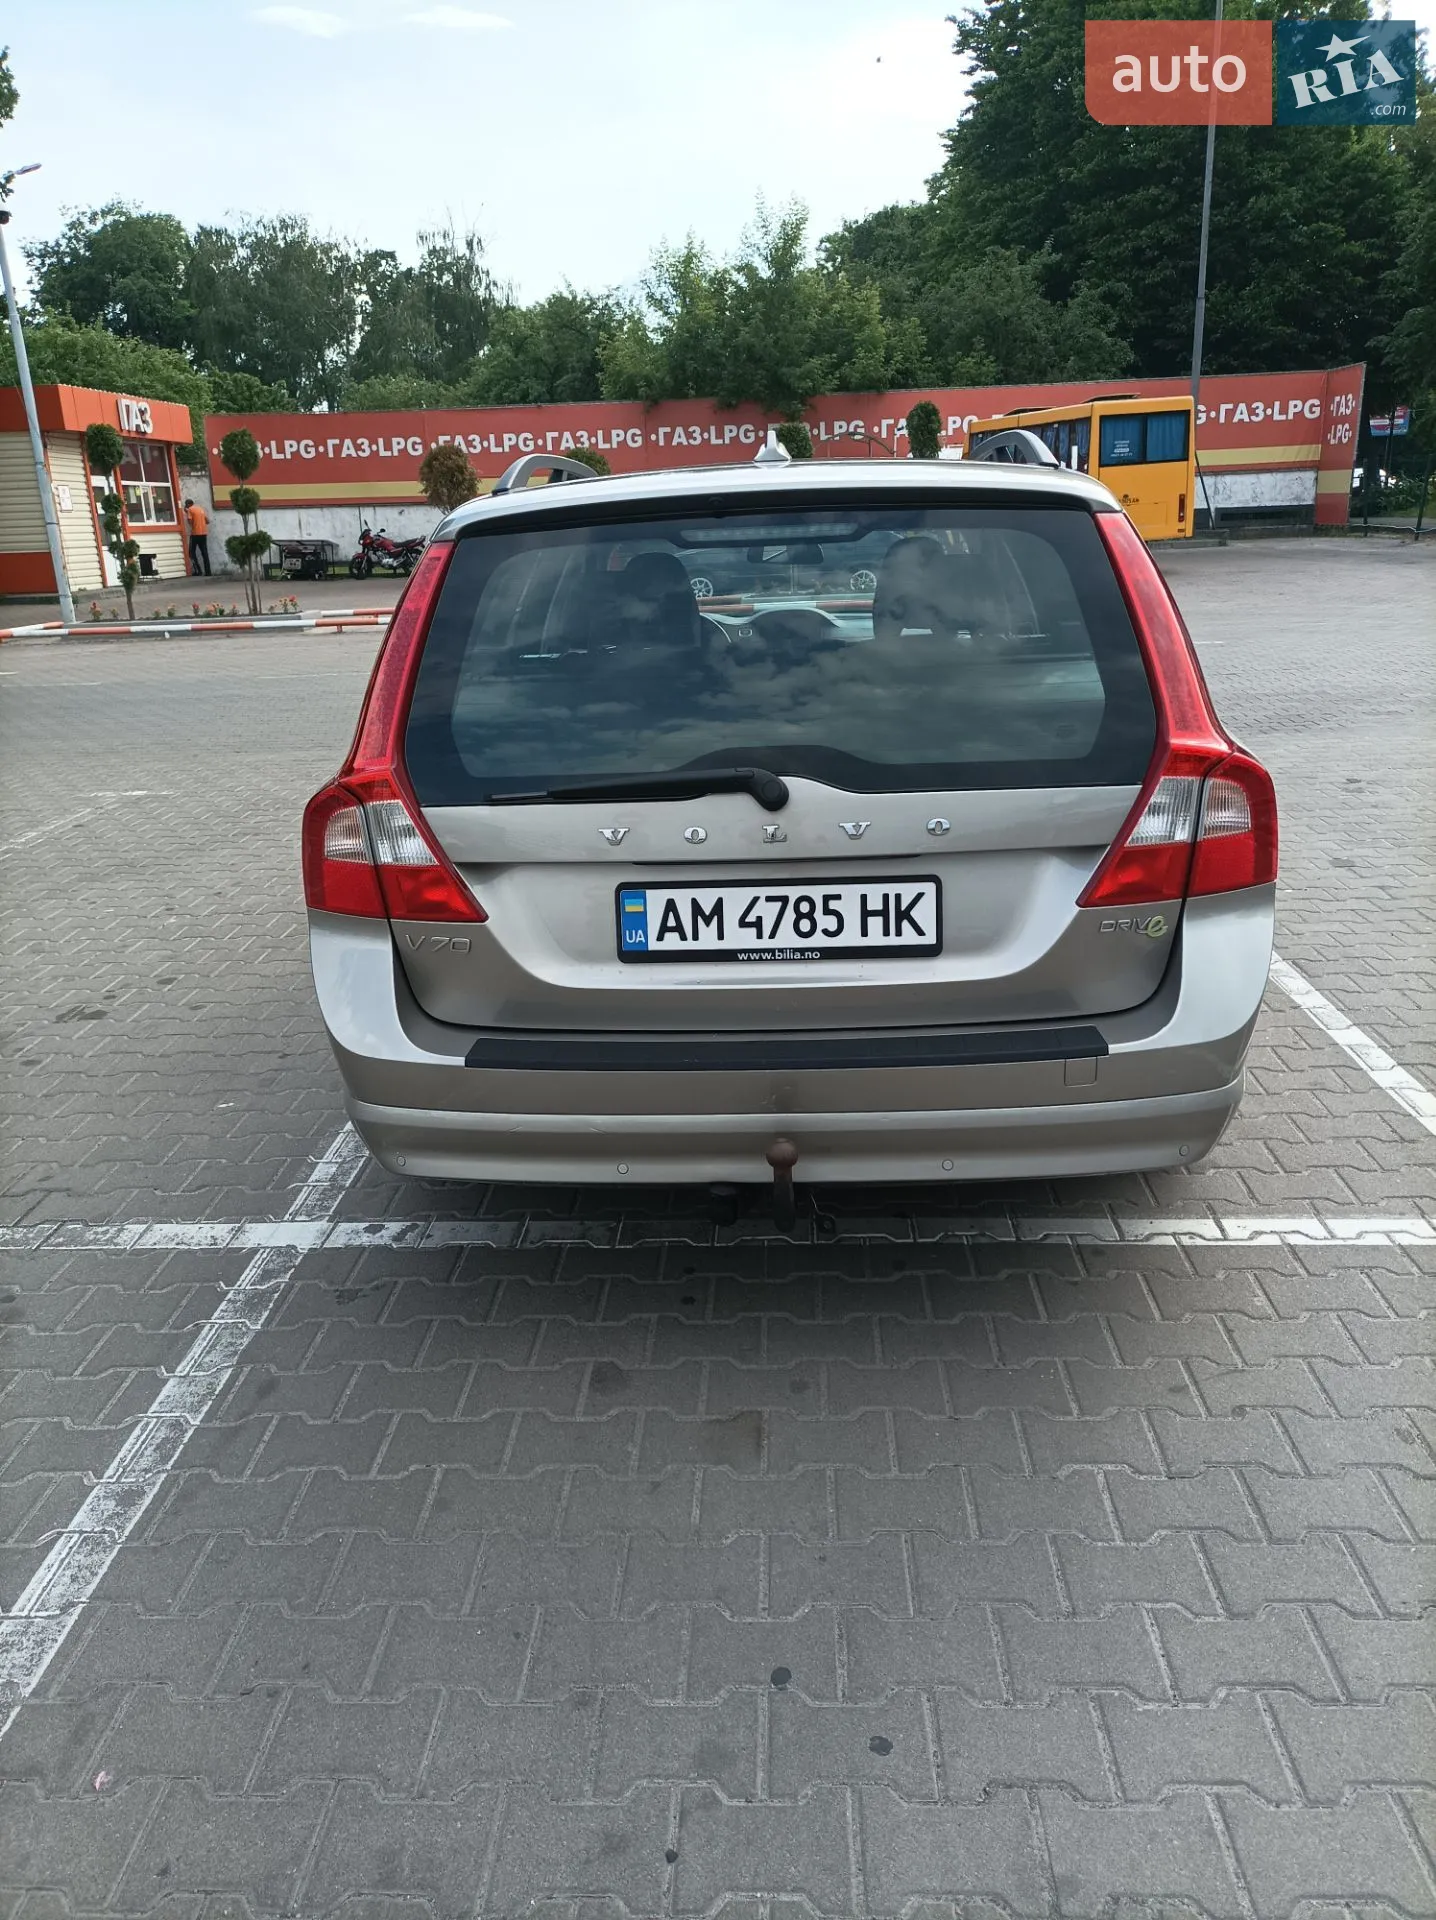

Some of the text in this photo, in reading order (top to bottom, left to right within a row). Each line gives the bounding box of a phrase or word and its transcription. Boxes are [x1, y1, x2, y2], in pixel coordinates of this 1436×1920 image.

[117, 398, 153, 434] ГАЗ
[1333, 393, 1353, 417] ГАЗ
[270, 439, 316, 459] LPG
[326, 437, 371, 458] ГАЗ
[377, 436, 424, 457] LPG
[489, 432, 535, 453] LPG
[545, 430, 590, 451] ГАЗ
[597, 428, 643, 449] LPG
[658, 425, 702, 446] ГАЗ
[709, 424, 756, 445] LPG
[819, 419, 865, 441] LPG
[1219, 401, 1265, 424] ГАЗ
[1273, 398, 1321, 421] LPG
[1329, 422, 1350, 445] LPG
[598, 817, 952, 846] VOLVO
[655, 891, 927, 942] AM 4785 HK
[625, 928, 646, 944] UA
[736, 949, 821, 961] www.bilia.no
